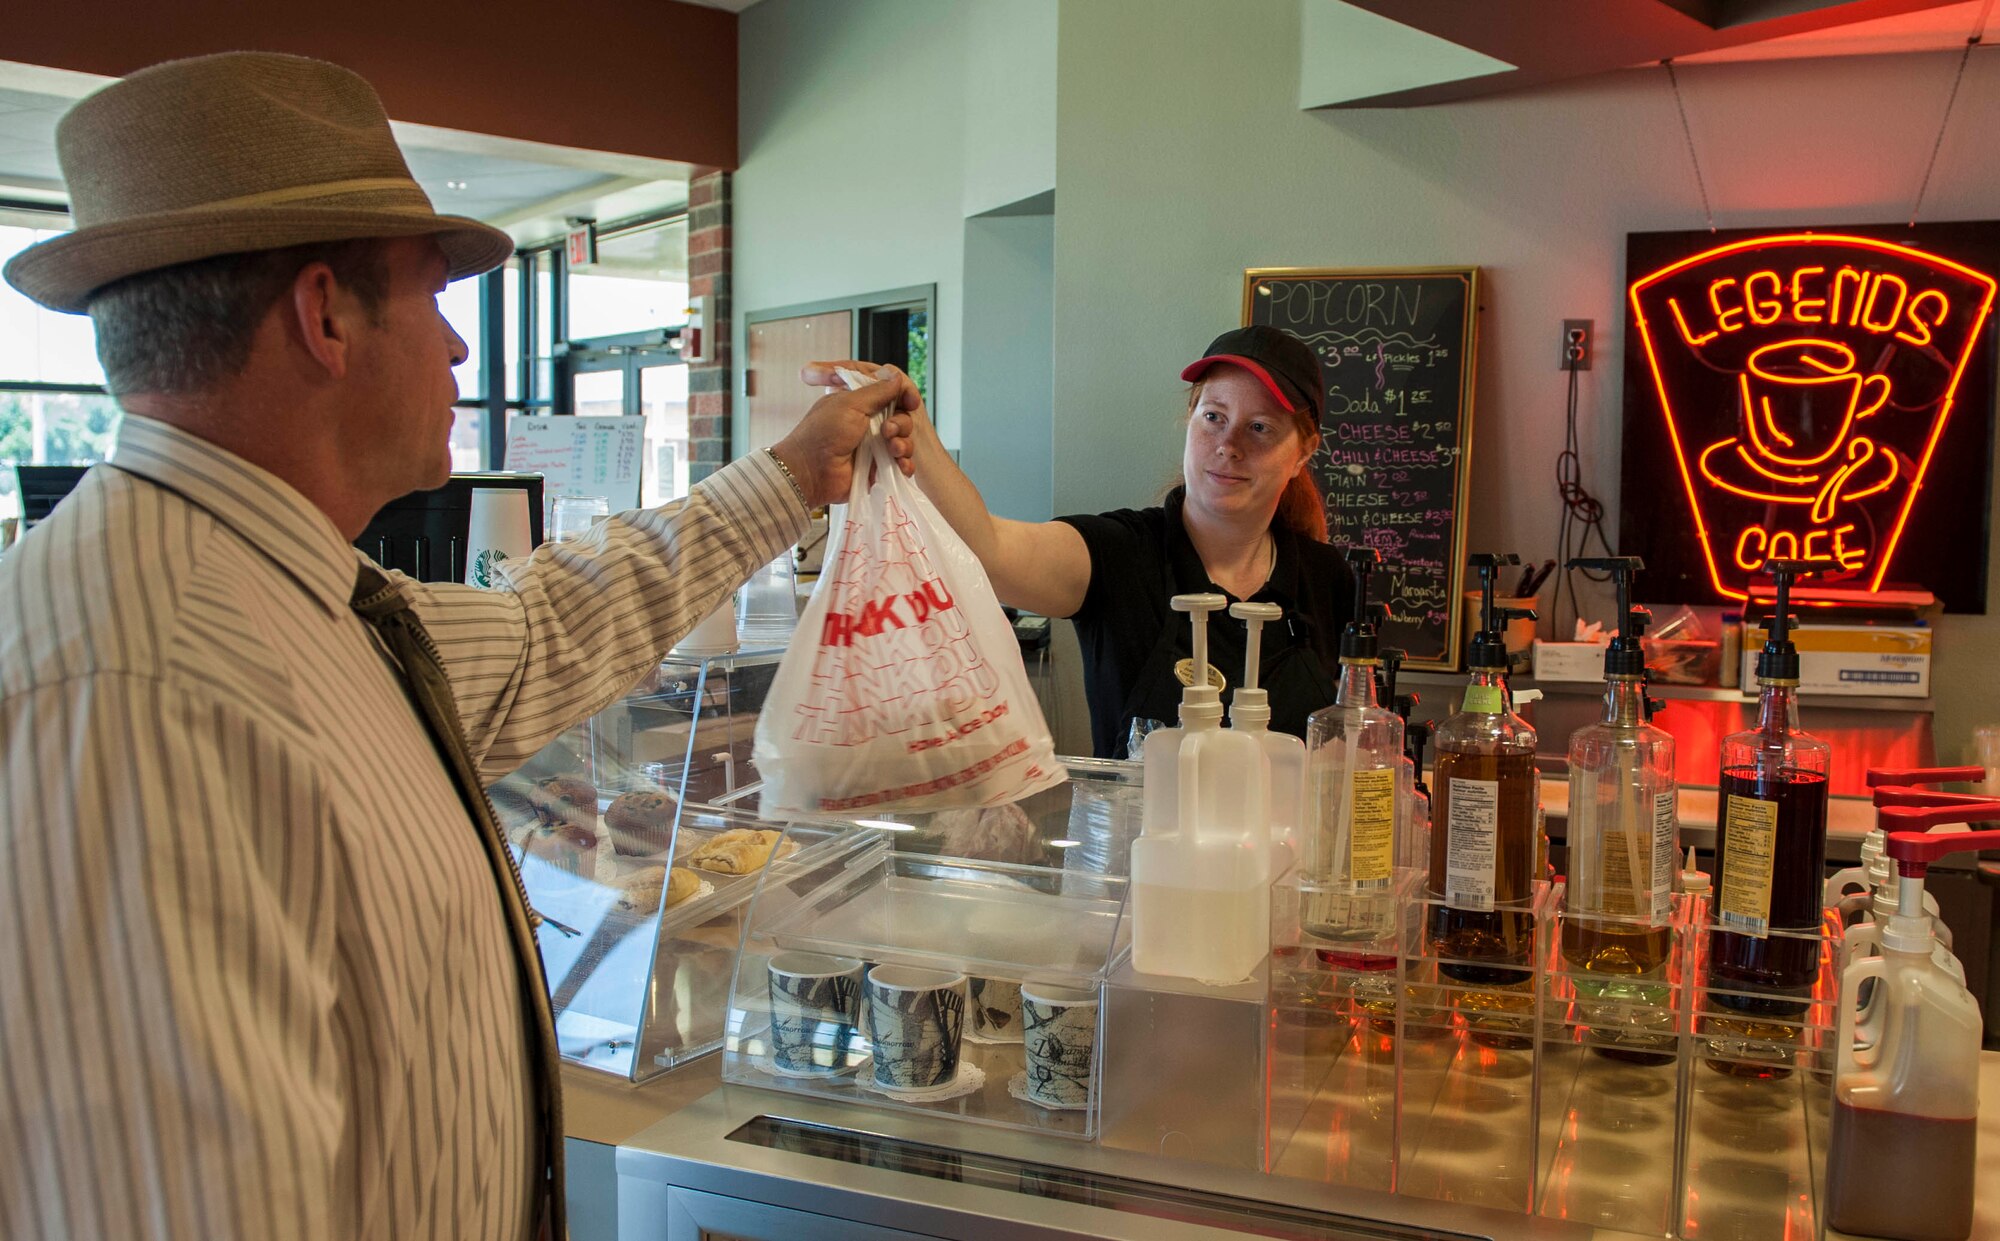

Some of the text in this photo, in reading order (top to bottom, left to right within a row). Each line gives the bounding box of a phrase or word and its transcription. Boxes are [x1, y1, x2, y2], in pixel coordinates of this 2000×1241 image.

[1267, 281, 1422, 325] POPCORN
[1668, 266, 1949, 345] LEGENDS
[1329, 386, 1382, 414] Soda
[1338, 422, 1411, 440] CHEESE
[1330, 450, 1370, 465] CHILI
[1383, 448, 1439, 463] CHEESE
[1324, 473, 1367, 488] PLAIN
[1326, 492, 1389, 507] CHEESE
[1325, 513, 1358, 526] CHILI
[1372, 512, 1423, 525] CHEESE
[1736, 525, 1866, 570] CAFE
